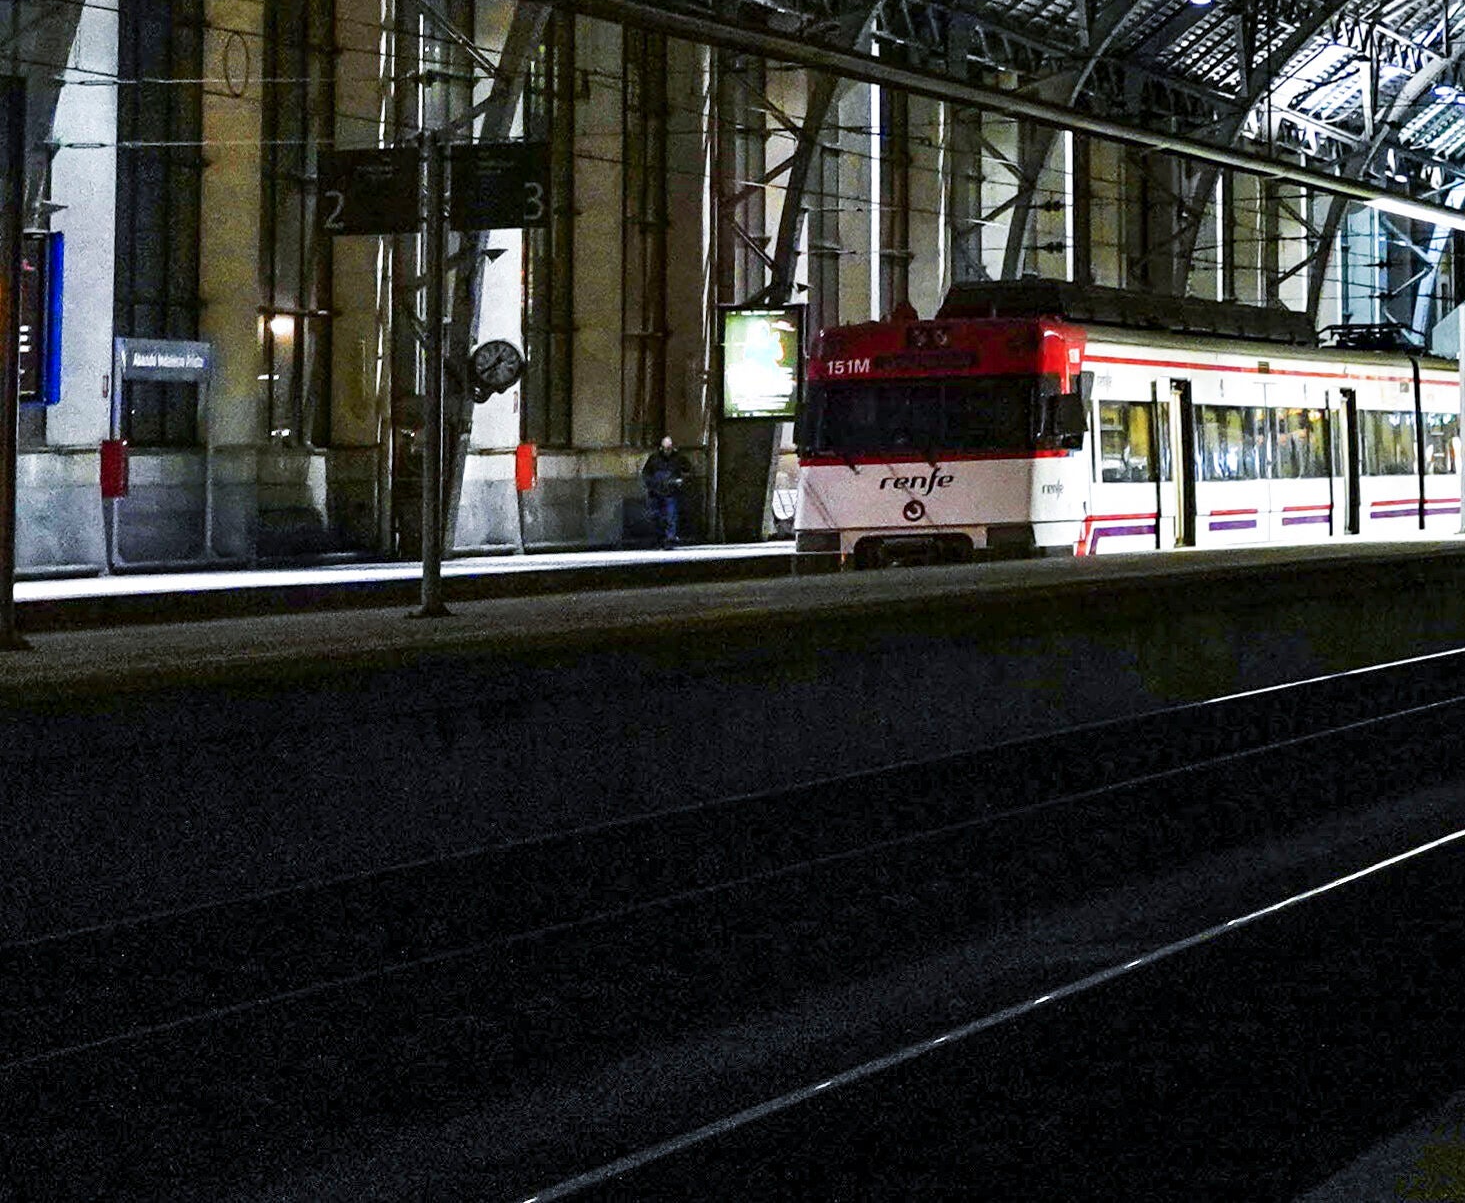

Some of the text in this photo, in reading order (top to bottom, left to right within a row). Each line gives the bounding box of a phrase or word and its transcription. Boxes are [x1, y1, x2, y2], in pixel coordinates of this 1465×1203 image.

[324, 190, 345, 229] 2
[524, 181, 544, 220] 3
[827, 358, 871, 375] 151M
[879, 467, 954, 496] renfe
